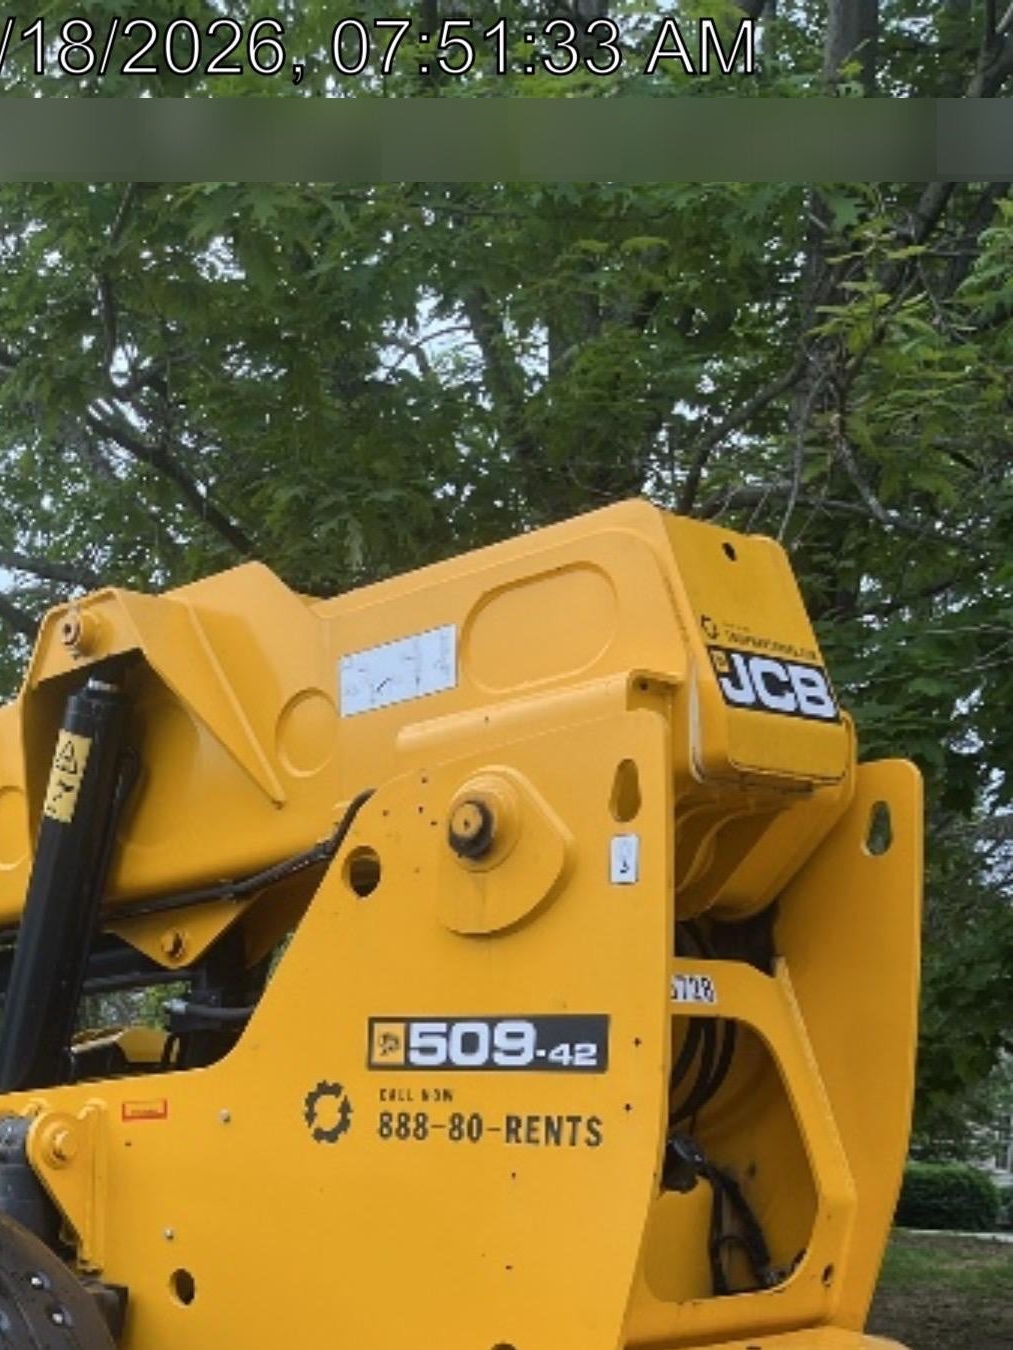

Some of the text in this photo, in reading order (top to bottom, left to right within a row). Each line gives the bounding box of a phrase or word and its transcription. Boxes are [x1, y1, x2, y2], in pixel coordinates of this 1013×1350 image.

[719, 652, 837, 718] JCB
[408, 1020, 598, 1067] 509-42
[379, 1110, 604, 1147] 888-80-RENTS
